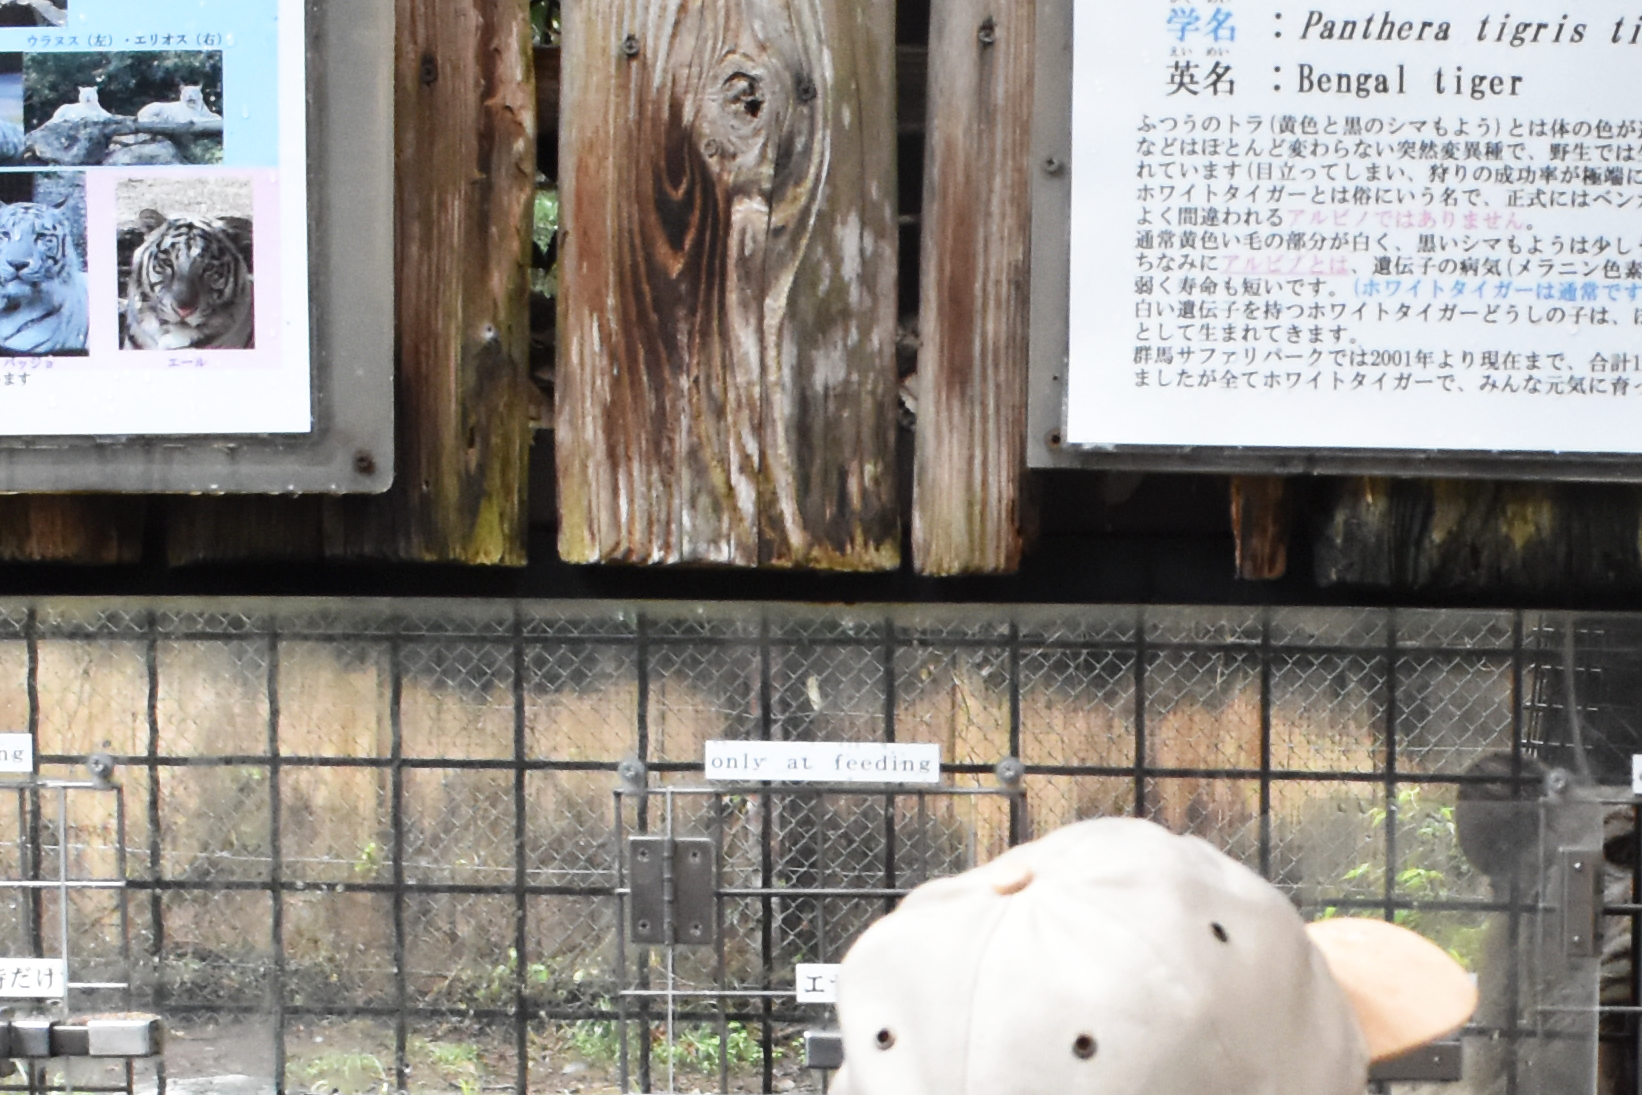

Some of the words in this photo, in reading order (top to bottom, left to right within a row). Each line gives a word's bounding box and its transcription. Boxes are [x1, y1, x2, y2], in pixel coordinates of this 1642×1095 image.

[1166, 7, 1237, 43] 学名
[1299, 10, 1451, 42] Panthera
[1476, 13, 1588, 48] tigris
[1166, 60, 1236, 97] 英名
[1297, 63, 1406, 99] Bengal
[1435, 66, 1523, 101] tiger
[1135, 323, 1359, 345] として生まれてきます。
[711, 754, 765, 770] only
[788, 755, 813, 770] at
[834, 754, 931, 772] feeding
[804, 975, 837, 993] エ
